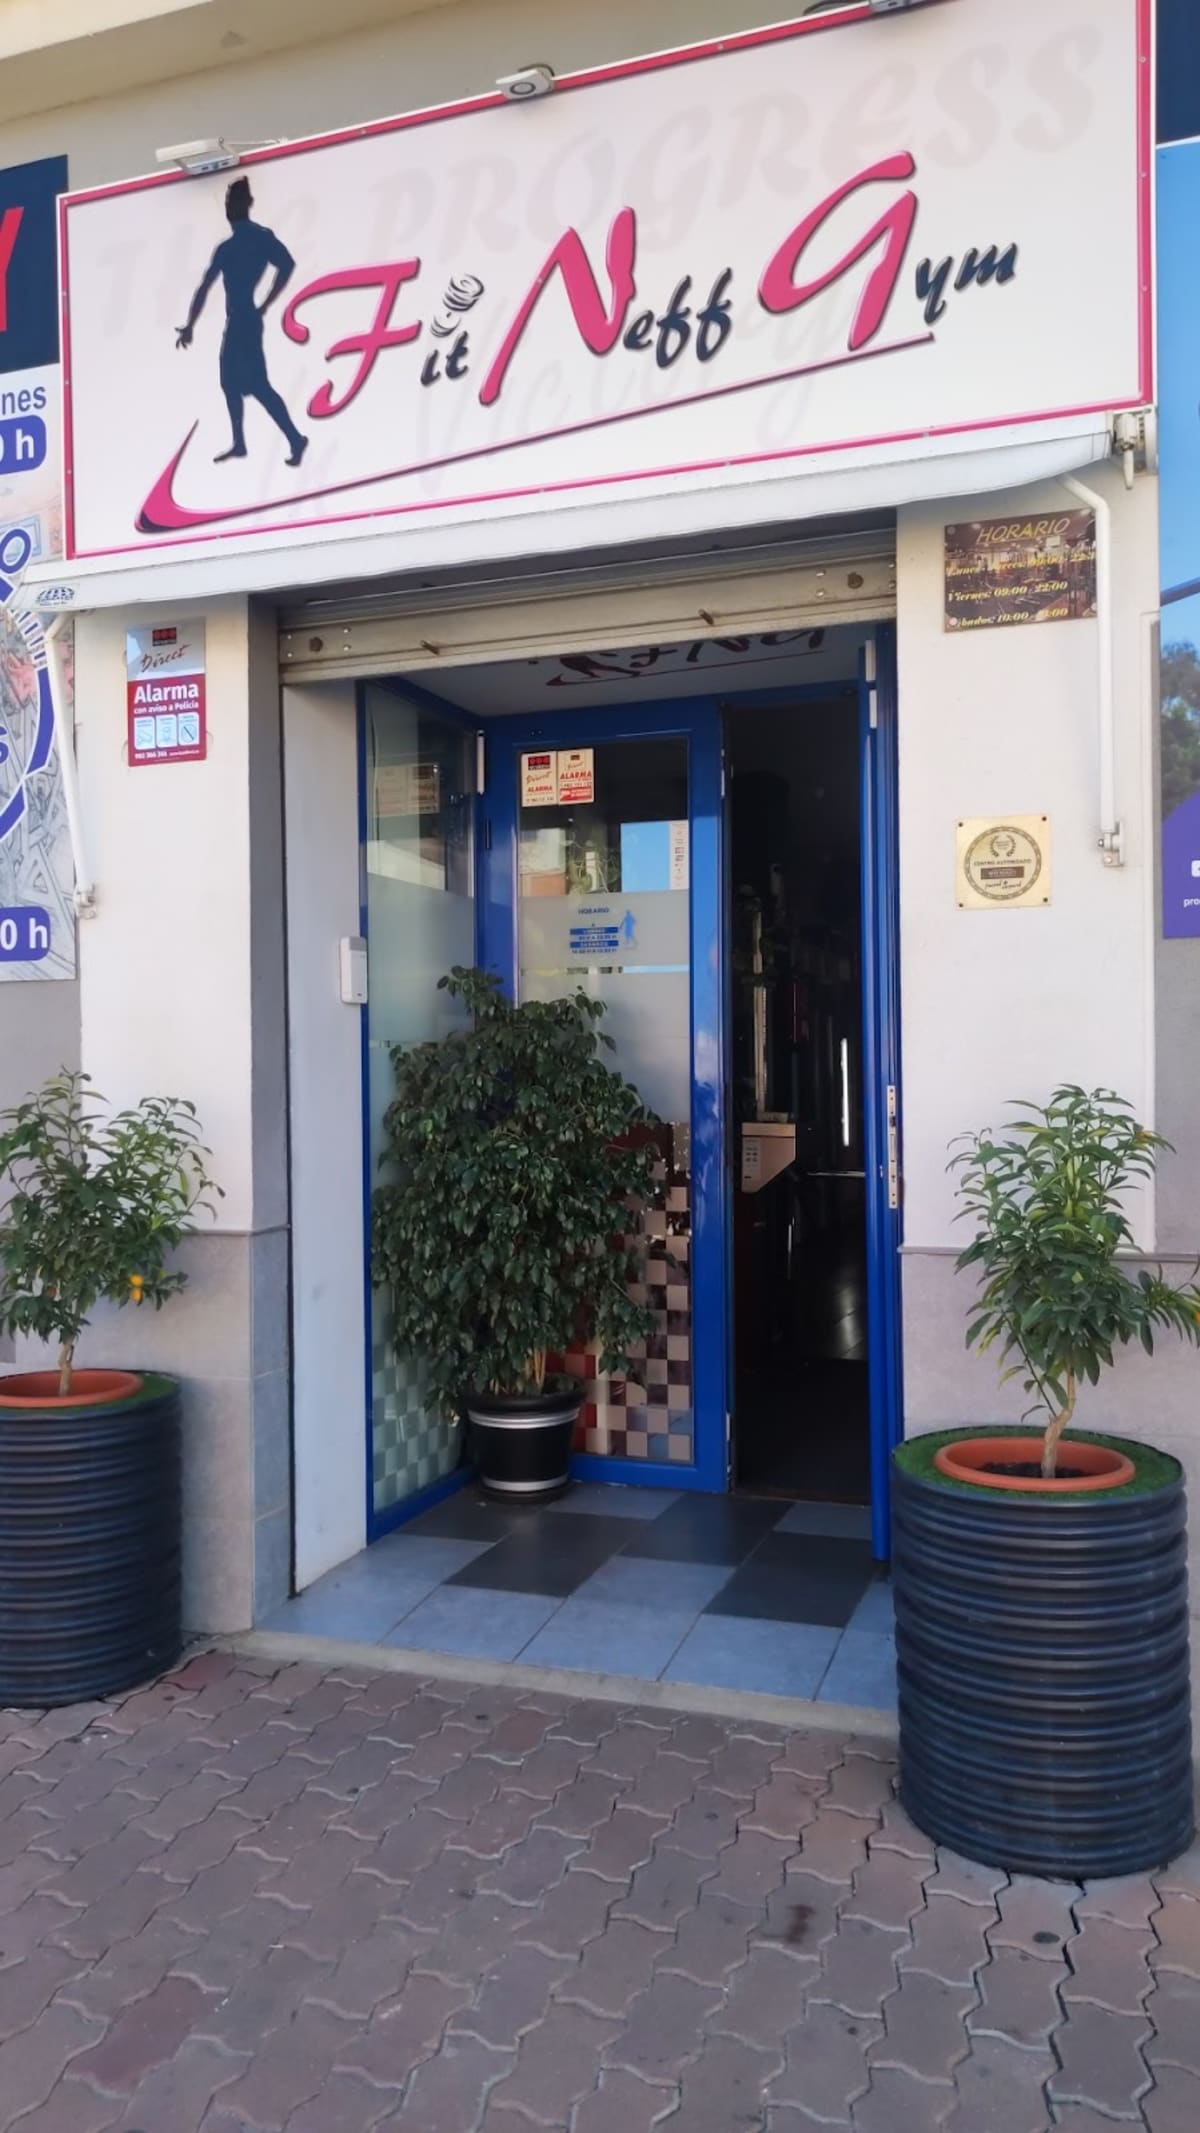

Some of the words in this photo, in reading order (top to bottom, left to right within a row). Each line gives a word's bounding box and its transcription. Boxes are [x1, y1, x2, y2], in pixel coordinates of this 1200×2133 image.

[757, 150, 1018, 353] Gym
[976, 518, 1071, 545] HORARIO
[994, 584, 1028, 598] 09:00
[1034, 580, 1069, 594] 22:00
[997, 610, 1030, 623] 10:00
[141, 644, 193, 673] Direct
[134, 683, 200, 705] Alarma
[559, 770, 592, 780] ALARMA
[527, 785, 553, 793] ALARMA
